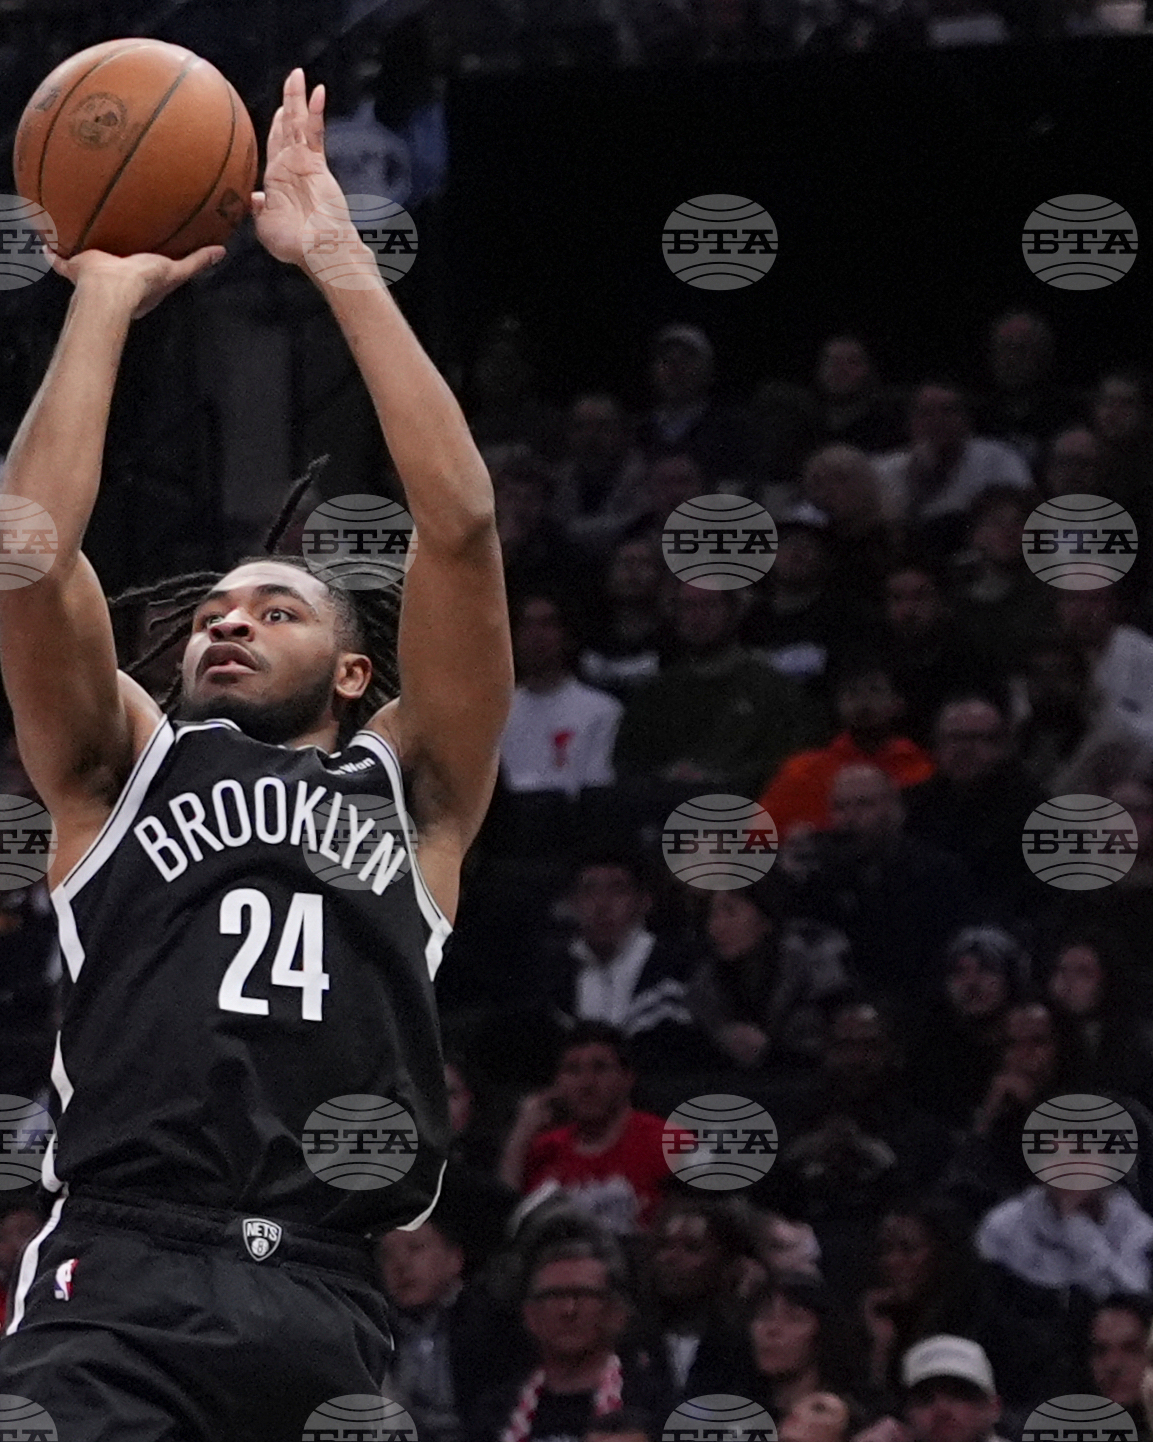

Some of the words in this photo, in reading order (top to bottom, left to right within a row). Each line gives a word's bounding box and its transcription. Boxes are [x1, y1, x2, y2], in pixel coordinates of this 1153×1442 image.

[133, 776, 407, 896] BROOKLYN
[218, 888, 330, 1021] 24
[246, 1222, 278, 1242] NETS
